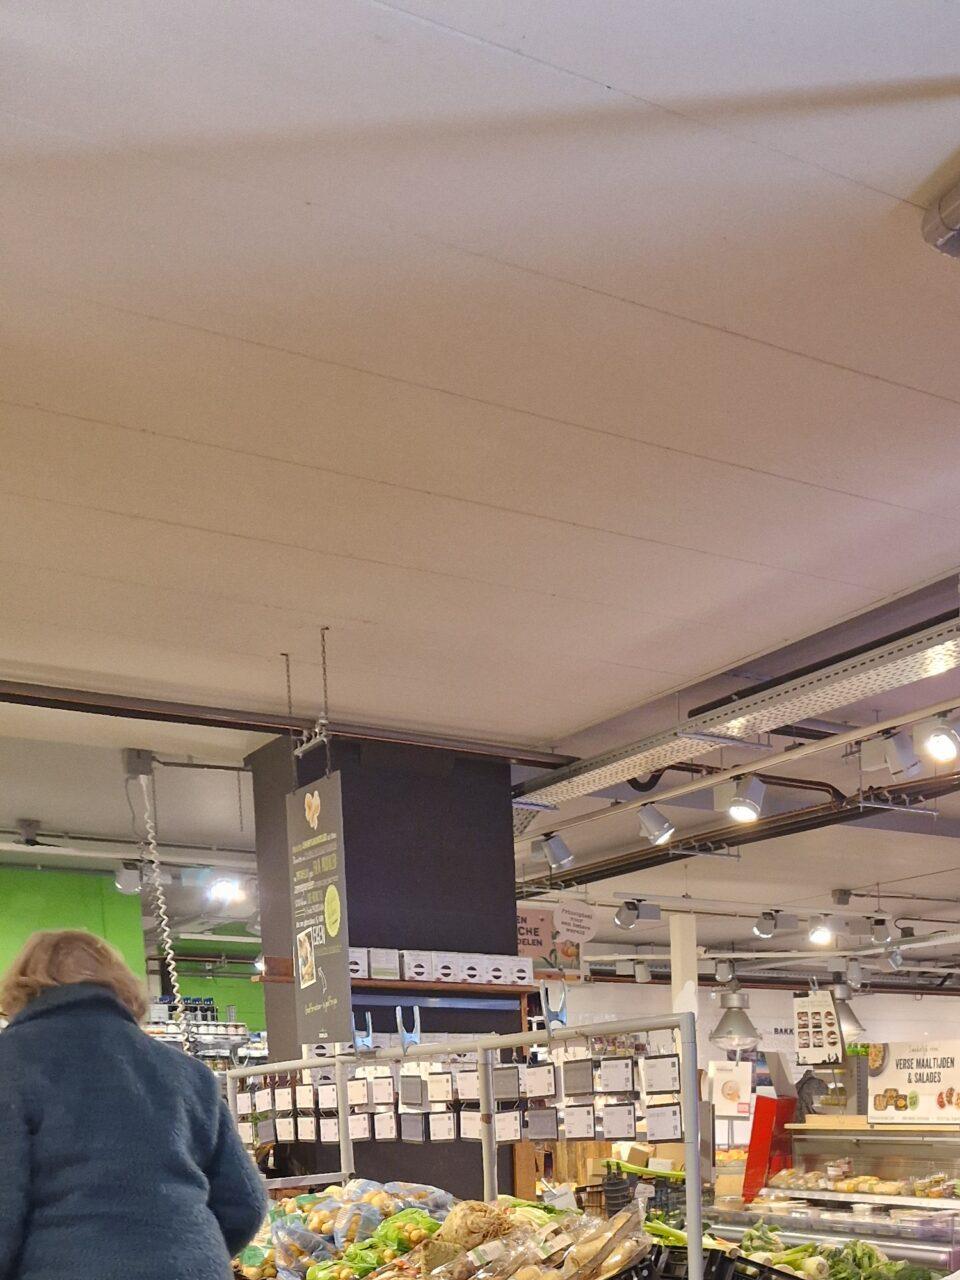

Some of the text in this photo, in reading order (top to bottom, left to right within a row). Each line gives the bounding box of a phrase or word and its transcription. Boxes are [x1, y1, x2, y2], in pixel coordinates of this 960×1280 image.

[895, 1056, 955, 1070] VERSE MAALTIJDEN
[914, 1071, 942, 1084] SALADES
